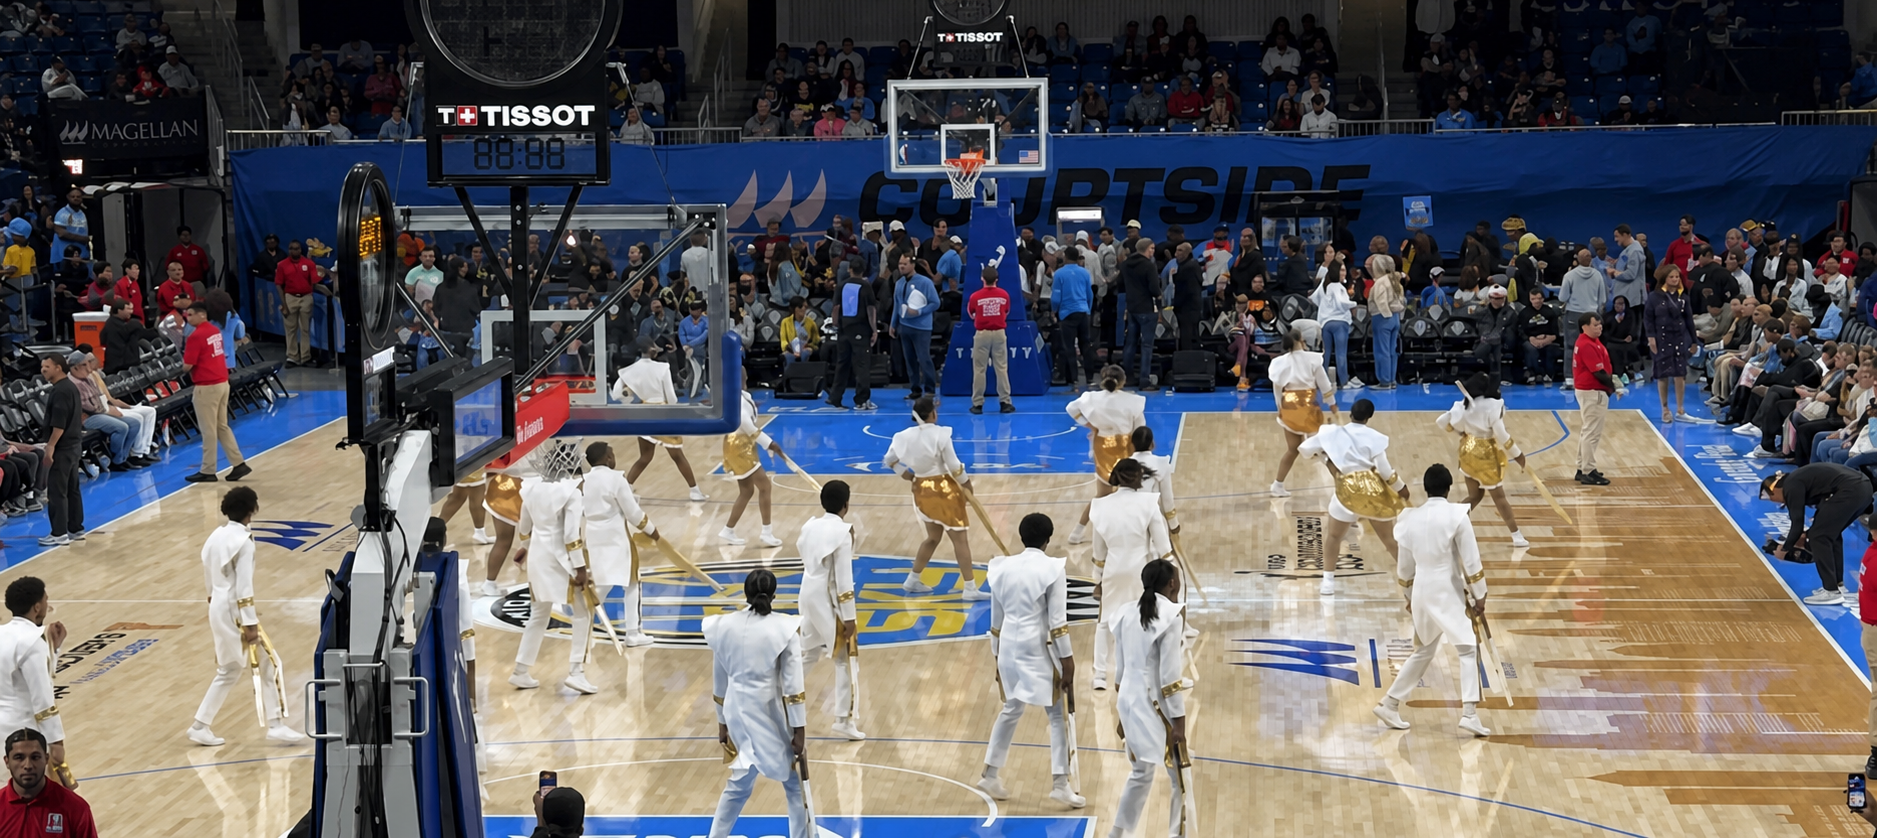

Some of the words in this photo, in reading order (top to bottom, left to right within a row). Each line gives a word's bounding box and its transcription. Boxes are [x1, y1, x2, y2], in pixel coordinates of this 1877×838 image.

[955, 32, 1003, 43] TISSOT
[480, 105, 596, 127] TISSOT
[91, 119, 198, 140] MAGELLAN
